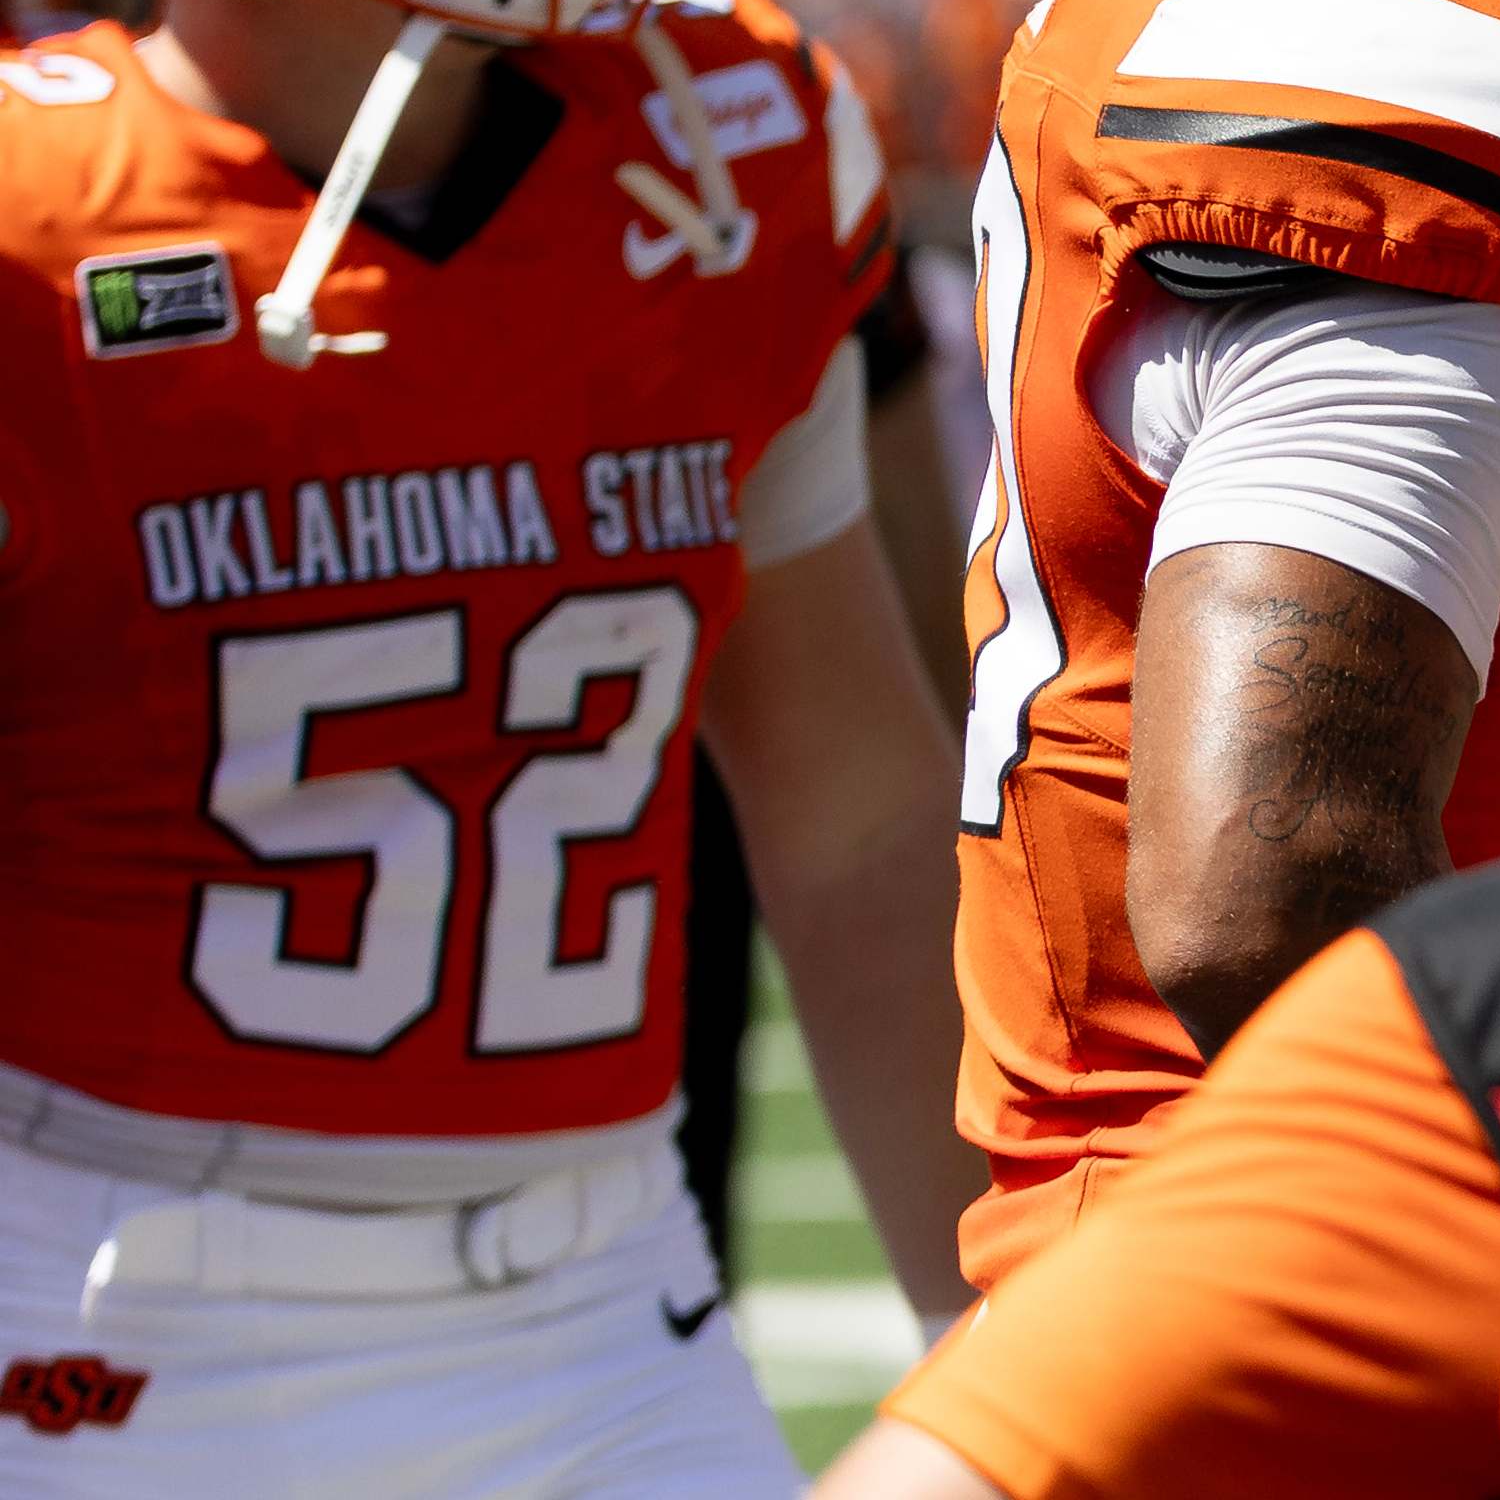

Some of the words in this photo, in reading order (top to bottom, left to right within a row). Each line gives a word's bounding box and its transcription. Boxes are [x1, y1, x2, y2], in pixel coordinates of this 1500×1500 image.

[137, 458, 560, 610] OKLAHOMA
[581, 437, 740, 558] STATE
[183, 584, 700, 1059] 52
